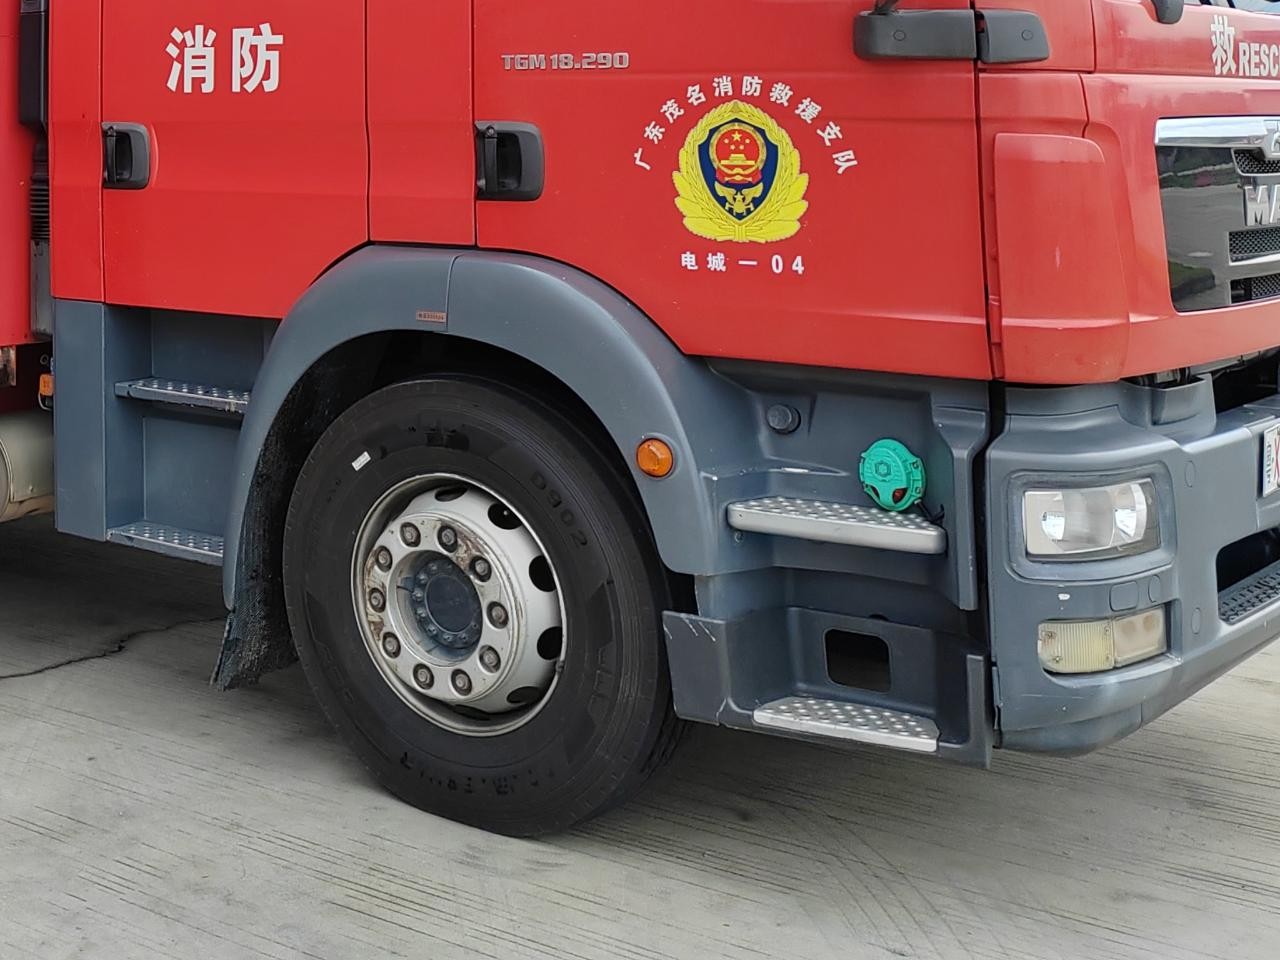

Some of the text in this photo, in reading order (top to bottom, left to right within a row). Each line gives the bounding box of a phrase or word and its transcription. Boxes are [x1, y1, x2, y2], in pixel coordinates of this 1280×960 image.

[165, 22, 284, 94] 消防
[501, 52, 630, 70] TGM 18.290
[1210, 14, 1280, 77] 救 RESC
[633, 75, 859, 175] 广东茂名消防救援支队
